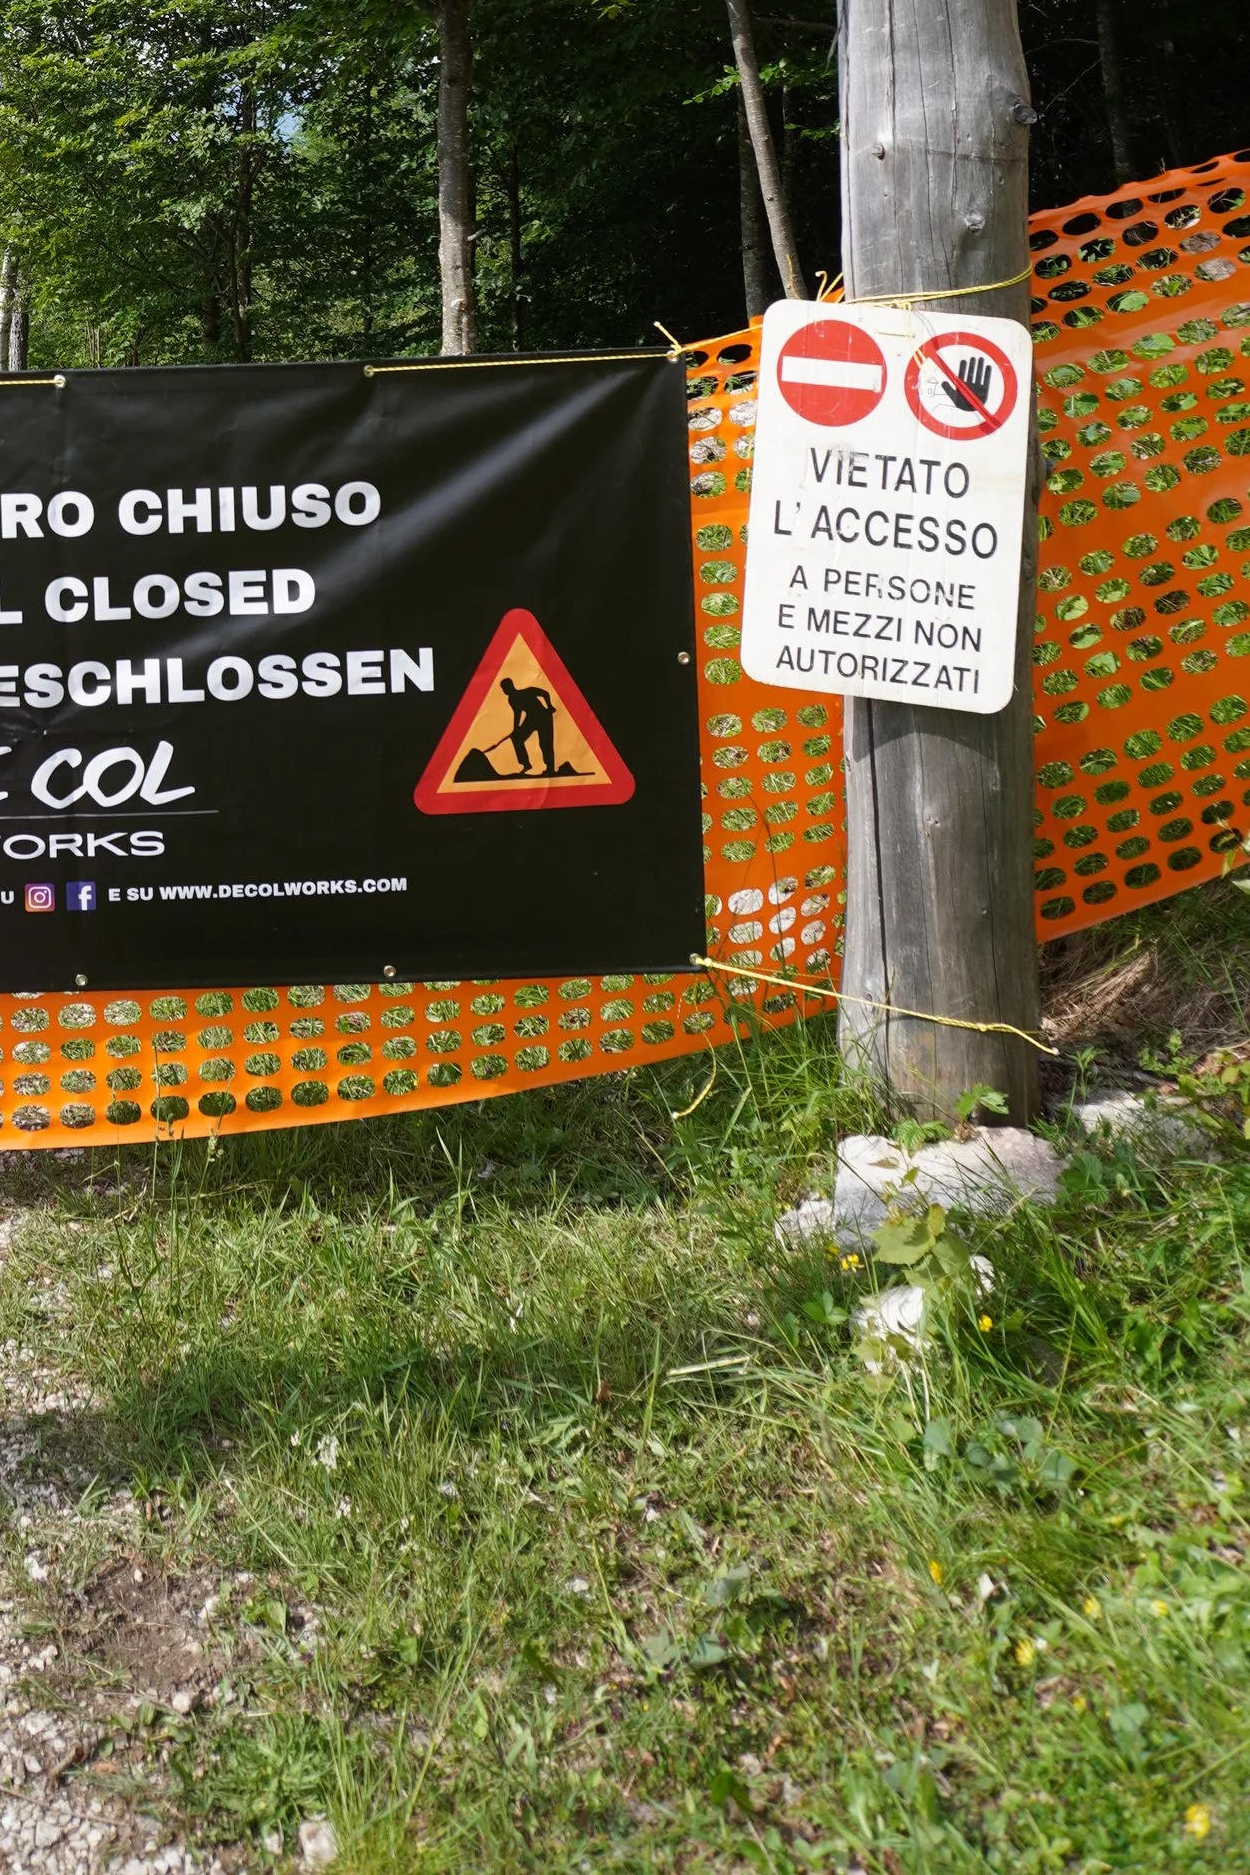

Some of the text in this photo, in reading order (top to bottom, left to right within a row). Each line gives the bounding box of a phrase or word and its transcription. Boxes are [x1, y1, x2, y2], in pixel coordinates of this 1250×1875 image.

[810, 447, 970, 499] VIETATO
[118, 481, 381, 536] CHIUSO
[44, 568, 316, 623] CLOSED
[789, 565, 976, 610] A PERSONE
[778, 603, 982, 652] E MEZZI NON
[775, 644, 981, 695] AUTORIZZATI
[30, 740, 196, 810] COL
[108, 888, 121, 902] E
[126, 887, 154, 901] SU
[159, 877, 407, 900] WWW.DECOLWORKS.COM
